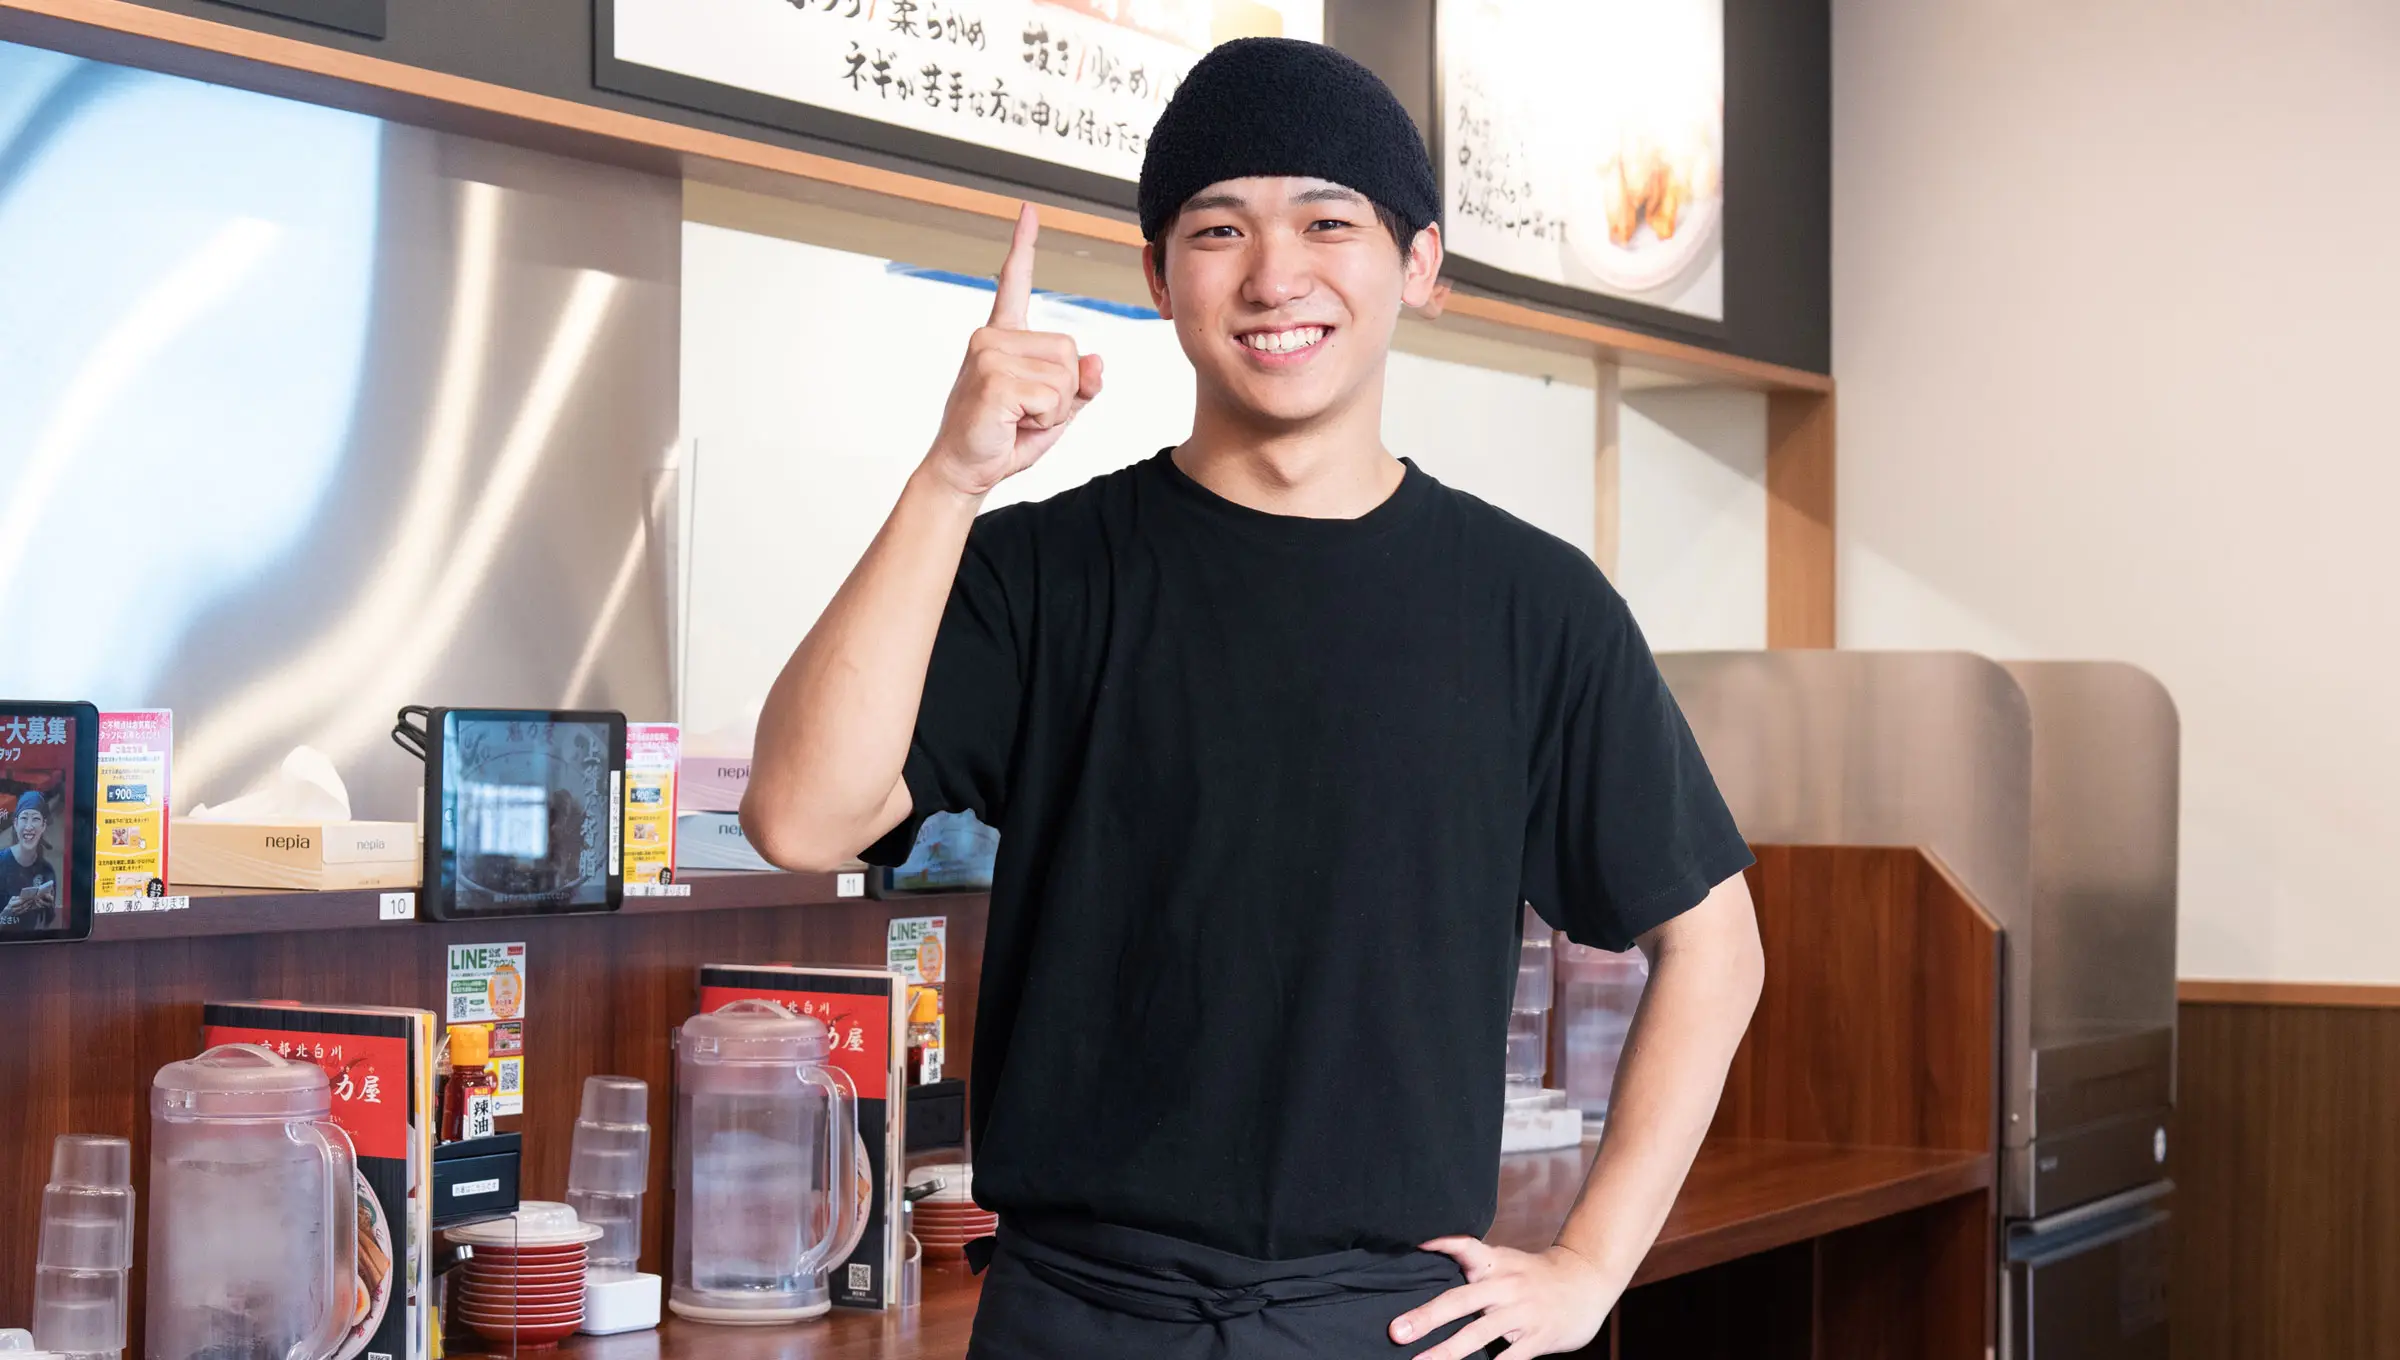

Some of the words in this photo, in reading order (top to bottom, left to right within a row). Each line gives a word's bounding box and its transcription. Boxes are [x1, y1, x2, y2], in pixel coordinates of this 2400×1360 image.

[717, 766, 752, 779] nepi
[265, 834, 310, 850] nepia
[356, 839, 385, 850] nepia
[846, 879, 857, 893] 11
[391, 898, 407, 915] 10
[890, 923, 917, 941] LINE
[451, 949, 487, 970] LINE
[333, 1074, 382, 1104] 力屋
[473, 1099, 489, 1135] 辣油
